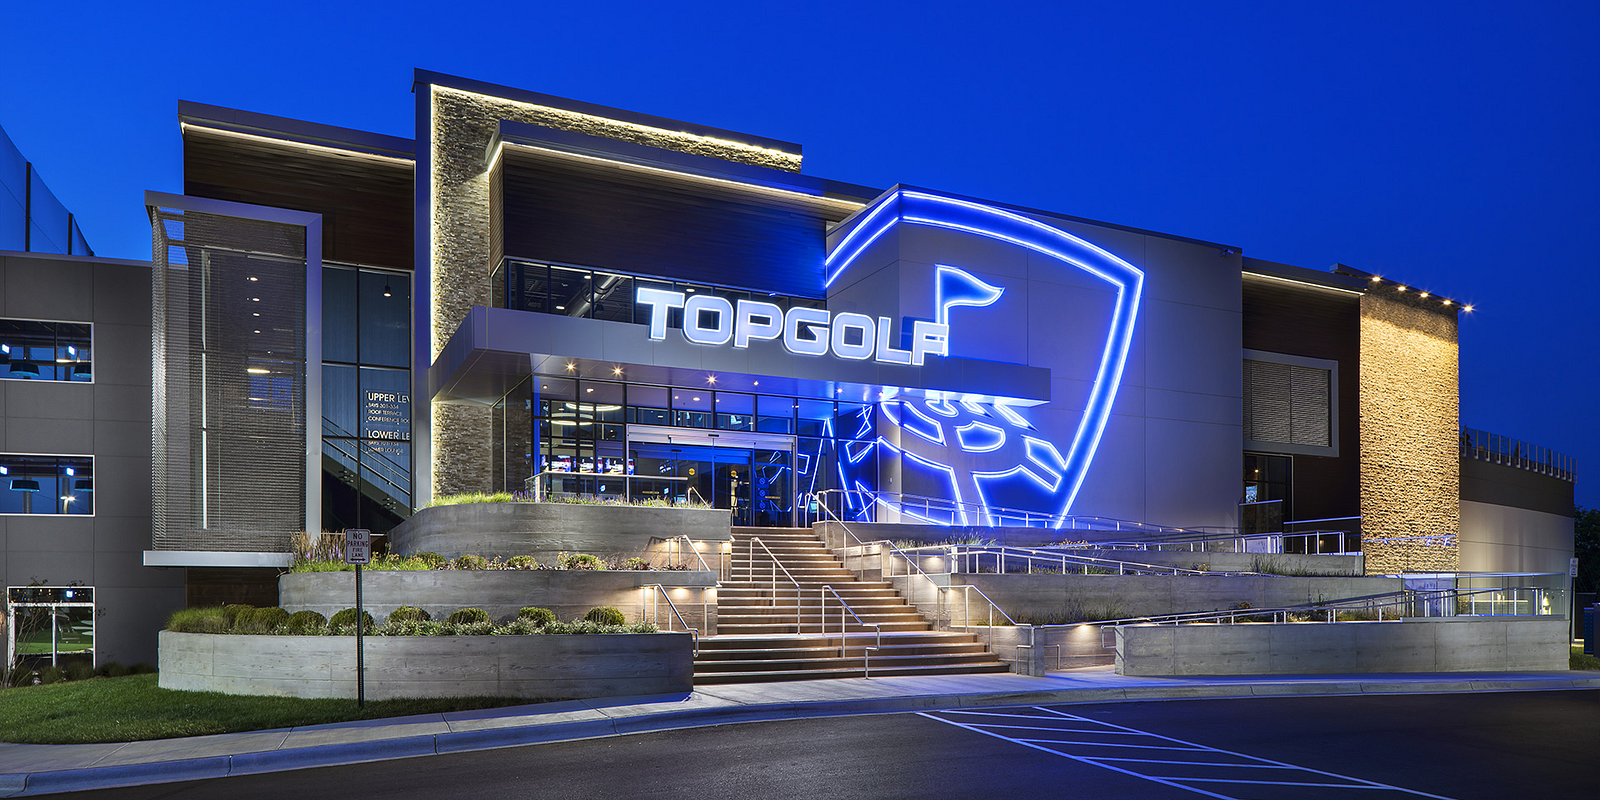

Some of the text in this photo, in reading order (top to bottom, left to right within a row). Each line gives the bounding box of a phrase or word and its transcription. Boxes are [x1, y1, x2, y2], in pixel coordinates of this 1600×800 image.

[636, 287, 949, 366] TOPGOLF
[368, 392, 395, 402] UPPER
[368, 415, 400, 423] CONFERENCE
[368, 430, 399, 440] LOWER
